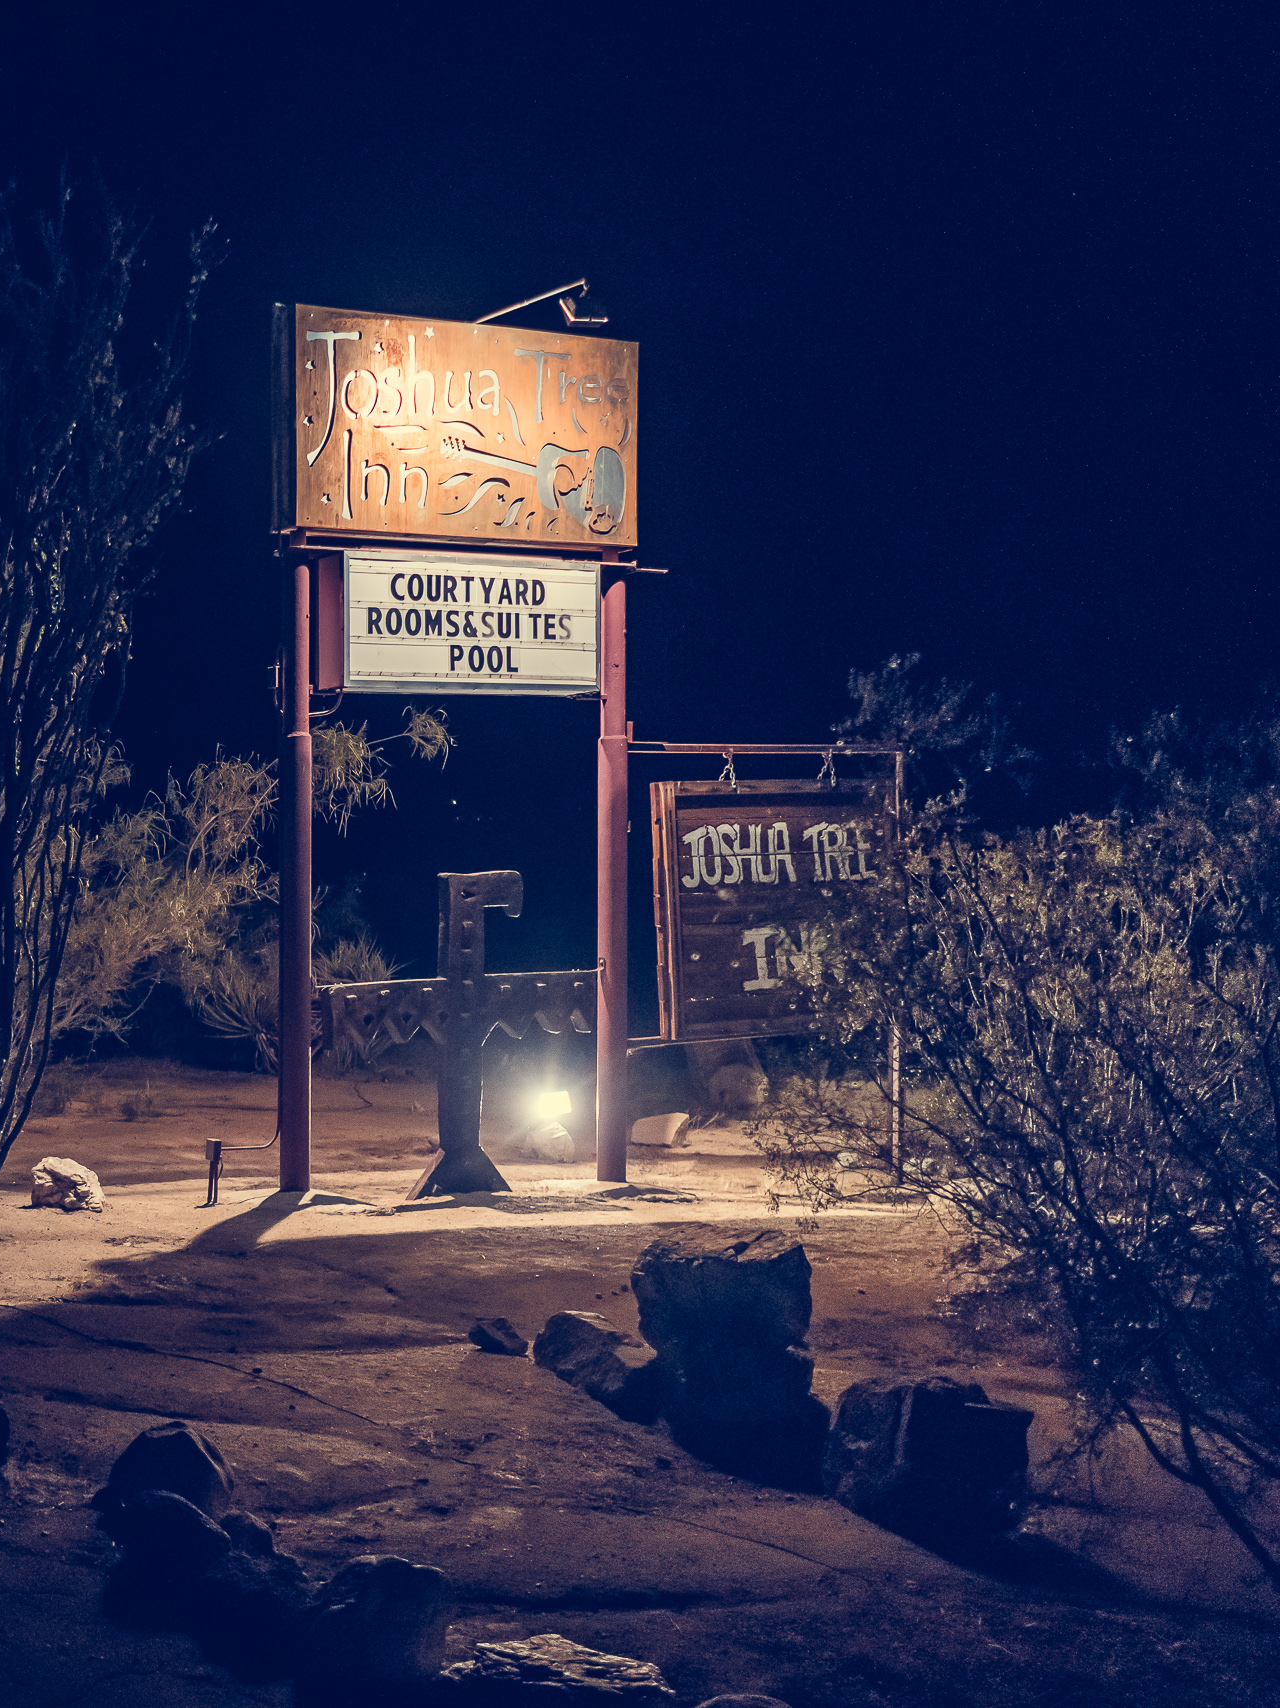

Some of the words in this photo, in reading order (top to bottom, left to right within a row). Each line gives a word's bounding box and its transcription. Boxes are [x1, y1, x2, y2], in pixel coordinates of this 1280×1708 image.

[306, 330, 500, 467] Joshua
[513, 348, 630, 424] Tree
[342, 428, 429, 520] Inn
[390, 572, 546, 606] COURTYARD
[449, 643, 519, 673] POOL
[681, 821, 797, 888] JOSHUA
[803, 821, 877, 882] TREE
